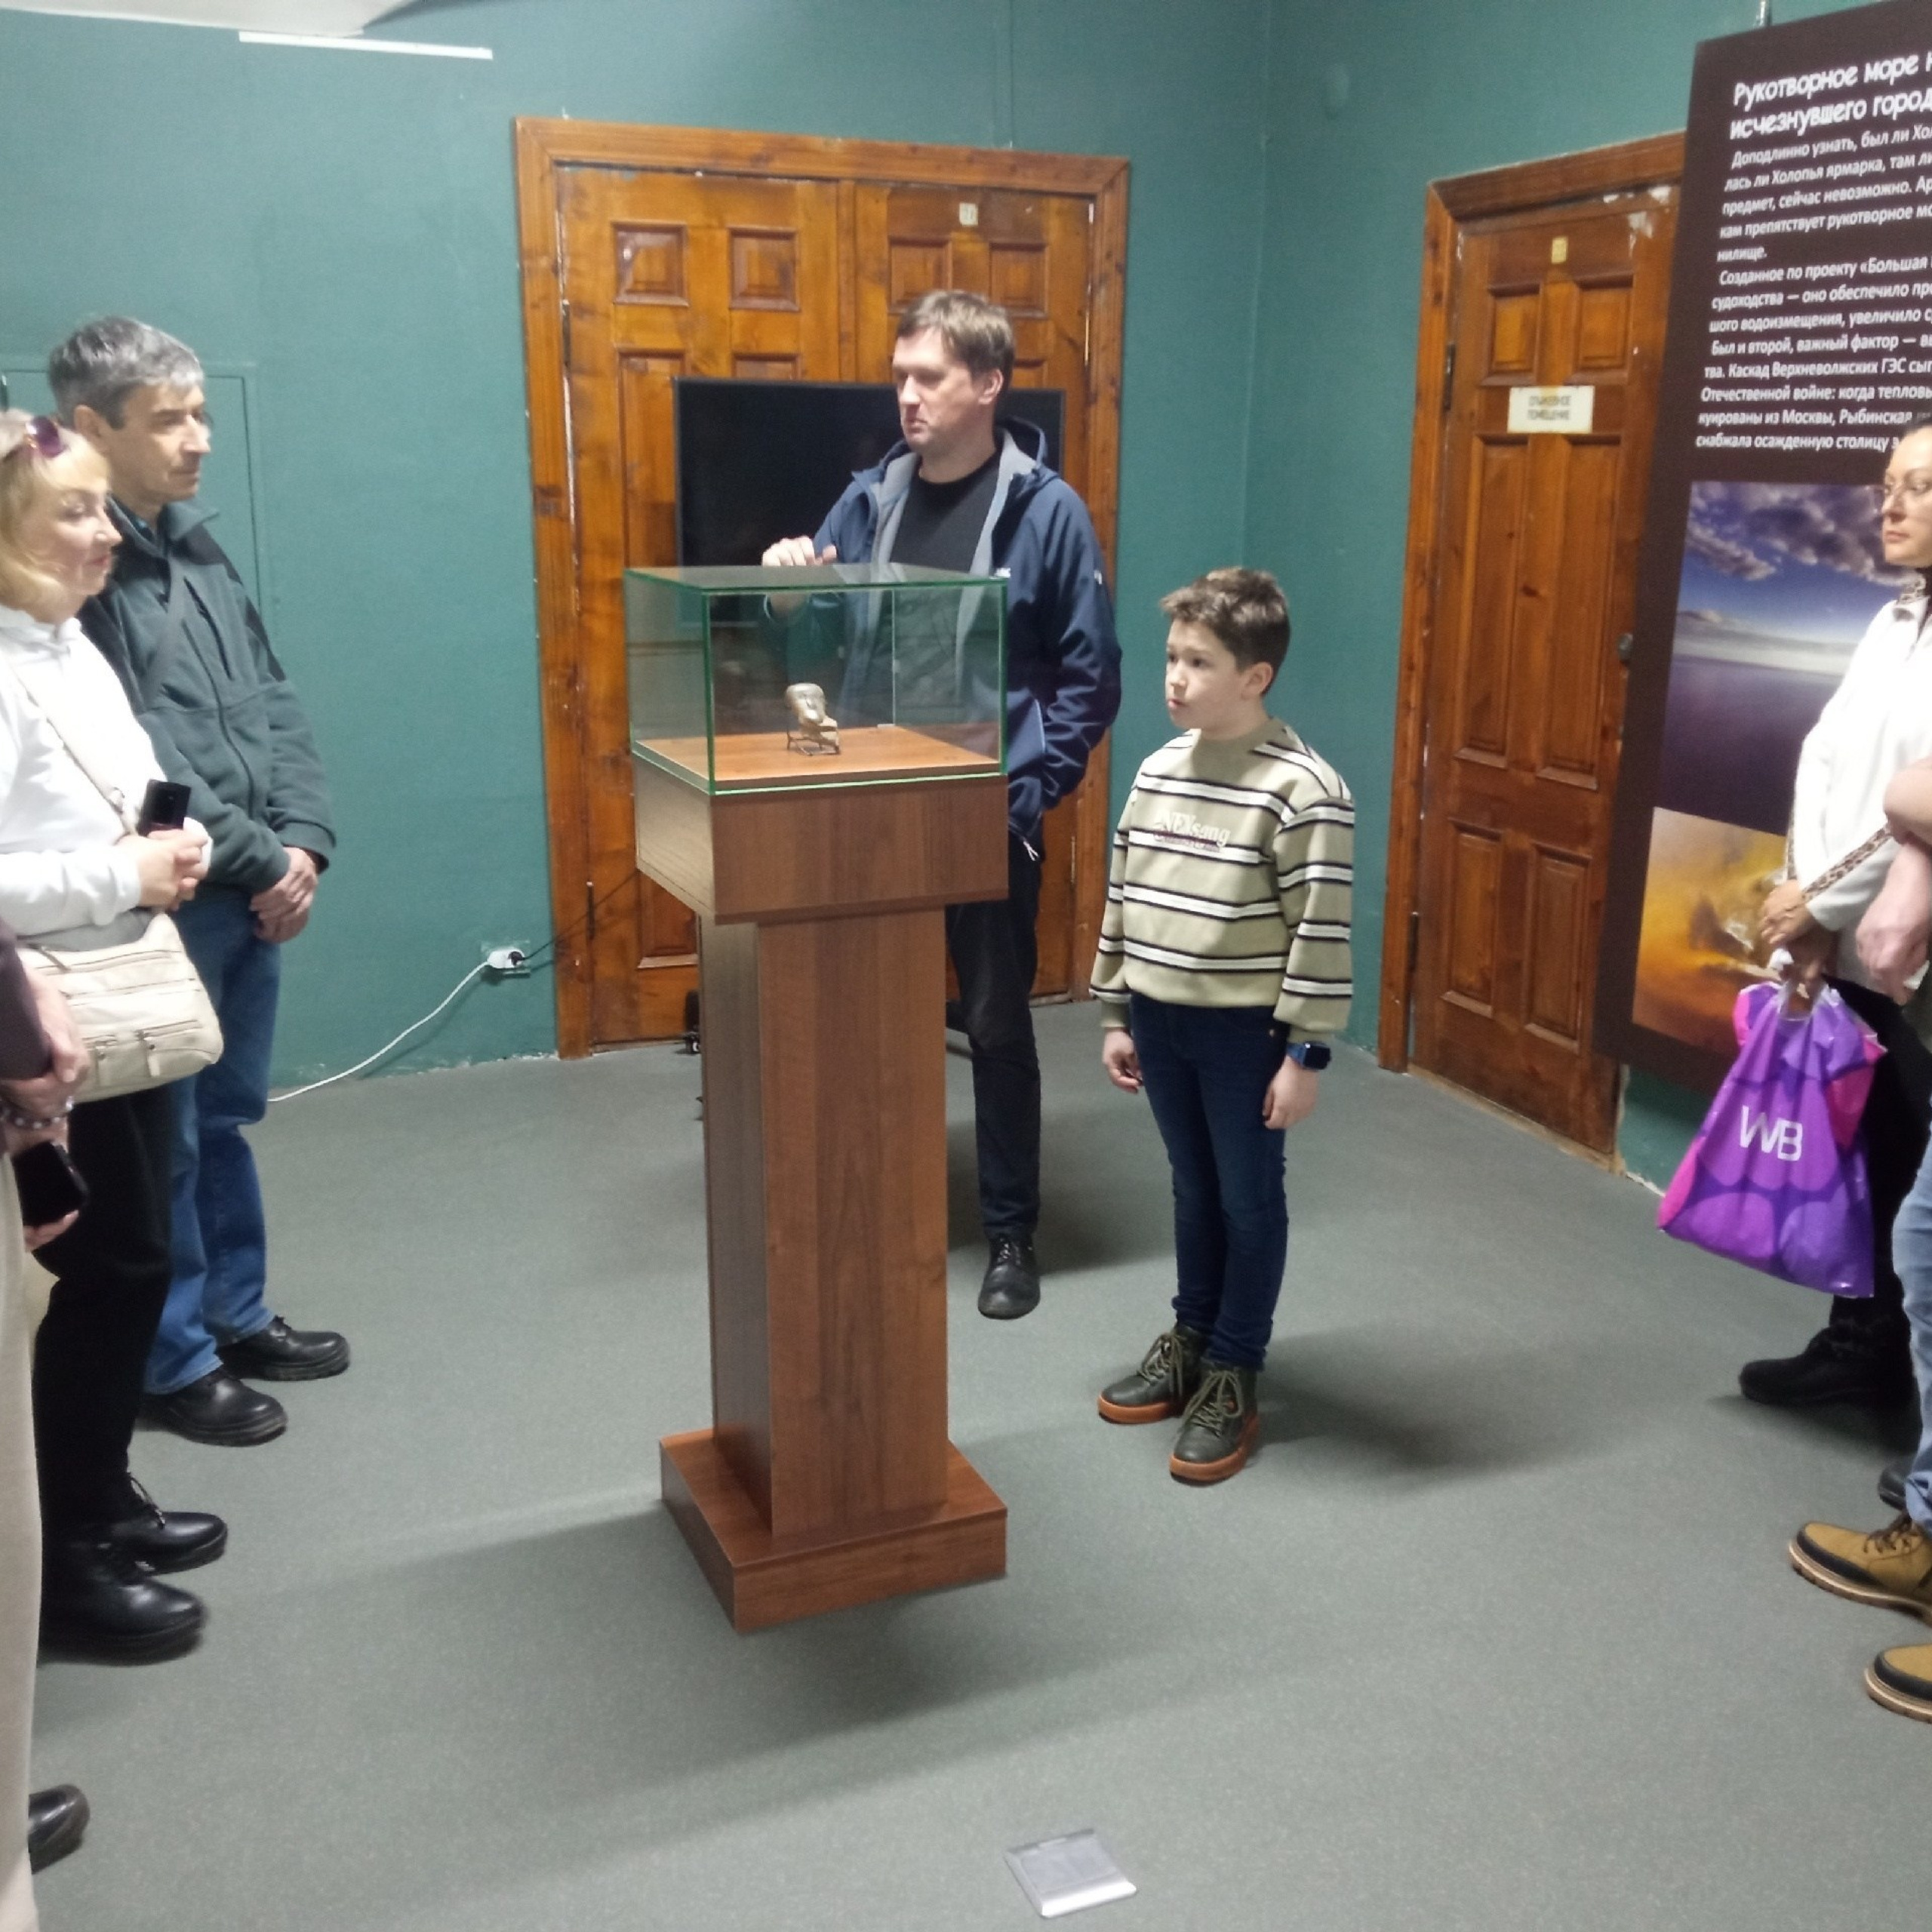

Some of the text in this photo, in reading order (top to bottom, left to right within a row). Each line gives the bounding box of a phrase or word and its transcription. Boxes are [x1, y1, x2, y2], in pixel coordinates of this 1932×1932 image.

[1733, 66, 1858, 112] Рукотворное
[1863, 54, 1919, 85] море
[1730, 100, 1867, 140] исчезнувшего
[1731, 125, 1932, 170] Доподлинно узнать, был ли Хо
[1724, 175, 1752, 192] лась
[1754, 174, 1770, 188] ли
[1771, 166, 1824, 185] Холопья
[1826, 157, 1885, 180] ярмарка,
[1890, 154, 1915, 169] там
[1722, 196, 1776, 217] предмет,
[1778, 191, 1821, 209] сейчас
[1823, 180, 1912, 203] невозможно.
[1720, 225, 1742, 238] кам
[1745, 215, 1826, 237] препятствует
[1827, 206, 1913, 230] рукотворное
[1716, 247, 1767, 262] нилище.
[1719, 257, 1928, 286] Созданное по проекту «Большая
[1712, 292, 1784, 312] судоходства
[1802, 290, 1826, 303] оно
[1829, 284, 1909, 302] обеспечило
[1709, 319, 1738, 333] шого
[1740, 312, 1846, 331] водоизмещения,
[1849, 309, 1921, 328] увеличило
[1712, 340, 1736, 356] Был
[1737, 342, 1746, 355] и
[1748, 337, 1794, 356] второй,
[1796, 334, 1848, 352] важный
[1850, 334, 1899, 353] фактор
[1704, 365, 1725, 378] тва.
[1728, 364, 1770, 380] Каскад
[1772, 361, 1878, 379] Верхневолжских
[1881, 358, 1906, 374] ГЭС
[1700, 385, 1790, 402] Отечественной
[1793, 384, 1836, 401] войне:
[1838, 386, 1875, 401] когда
[1699, 411, 1763, 426] куированы
[1764, 412, 1779, 424] из
[1783, 409, 1836, 426] Москвы,
[1839, 408, 1912, 425] Рыбинская
[1695, 432, 1752, 448] снабжала
[1754, 435, 1834, 452] осажденную
[1836, 435, 1889, 453] столицу
[1739, 1105, 1803, 1161] WB
